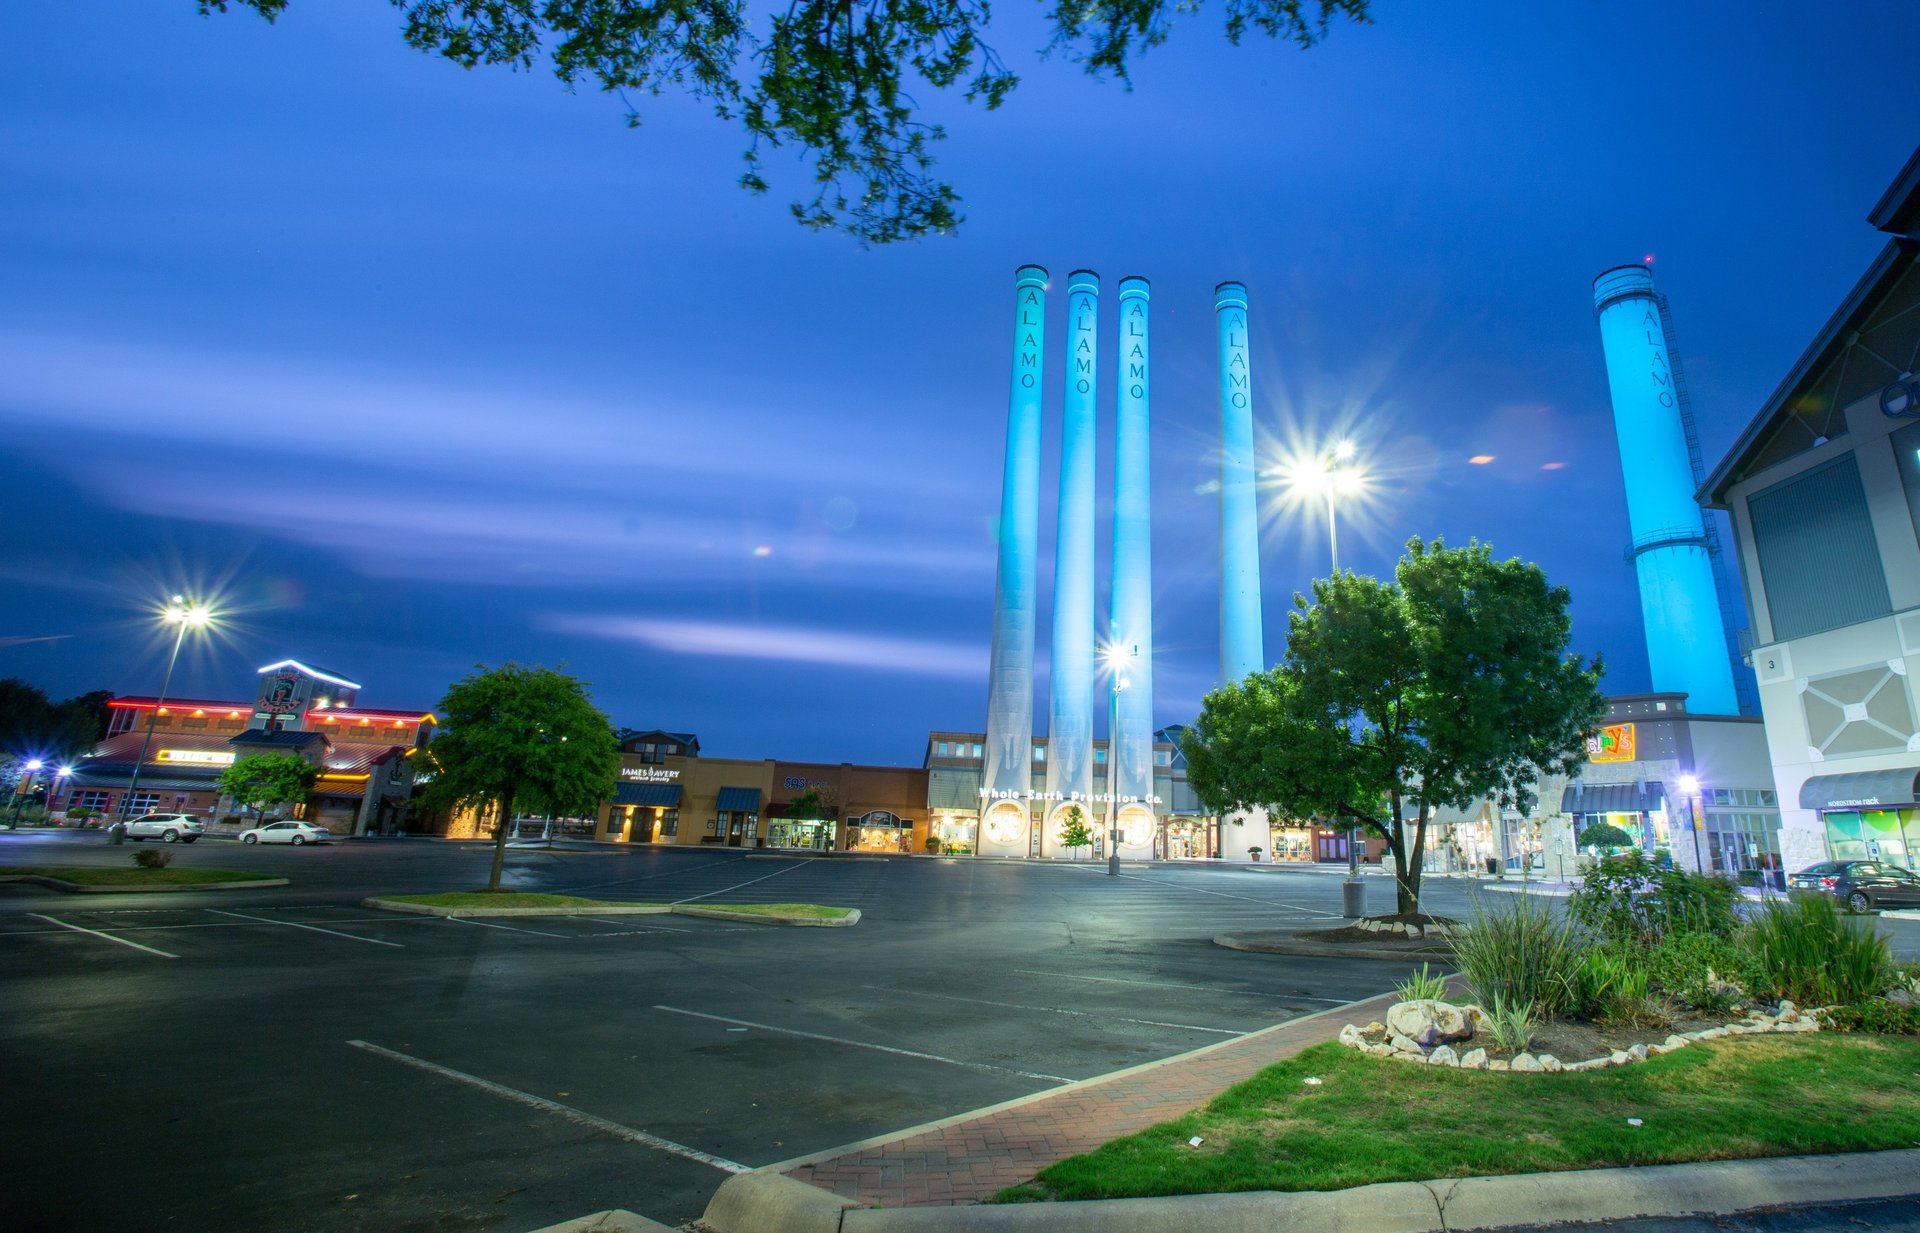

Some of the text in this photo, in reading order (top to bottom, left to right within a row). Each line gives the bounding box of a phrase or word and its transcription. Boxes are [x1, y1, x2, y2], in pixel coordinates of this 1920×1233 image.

[1021, 291, 1038, 389] ALAMO
[1076, 296, 1092, 394] ALAMO
[1129, 303, 1145, 399] ALAMO
[1228, 312, 1248, 409] ALAMO
[1642, 311, 1674, 409] ALAMO
[1768, 660, 1775, 669] 3
[259, 696, 301, 713] TORTILLA
[621, 768, 680, 778] JAMES AVERY
[784, 776, 807, 790] SAS
[979, 787, 1163, 804] Whole Earth Provision Co.
[1827, 796, 1880, 807] NORDSTROM rack
